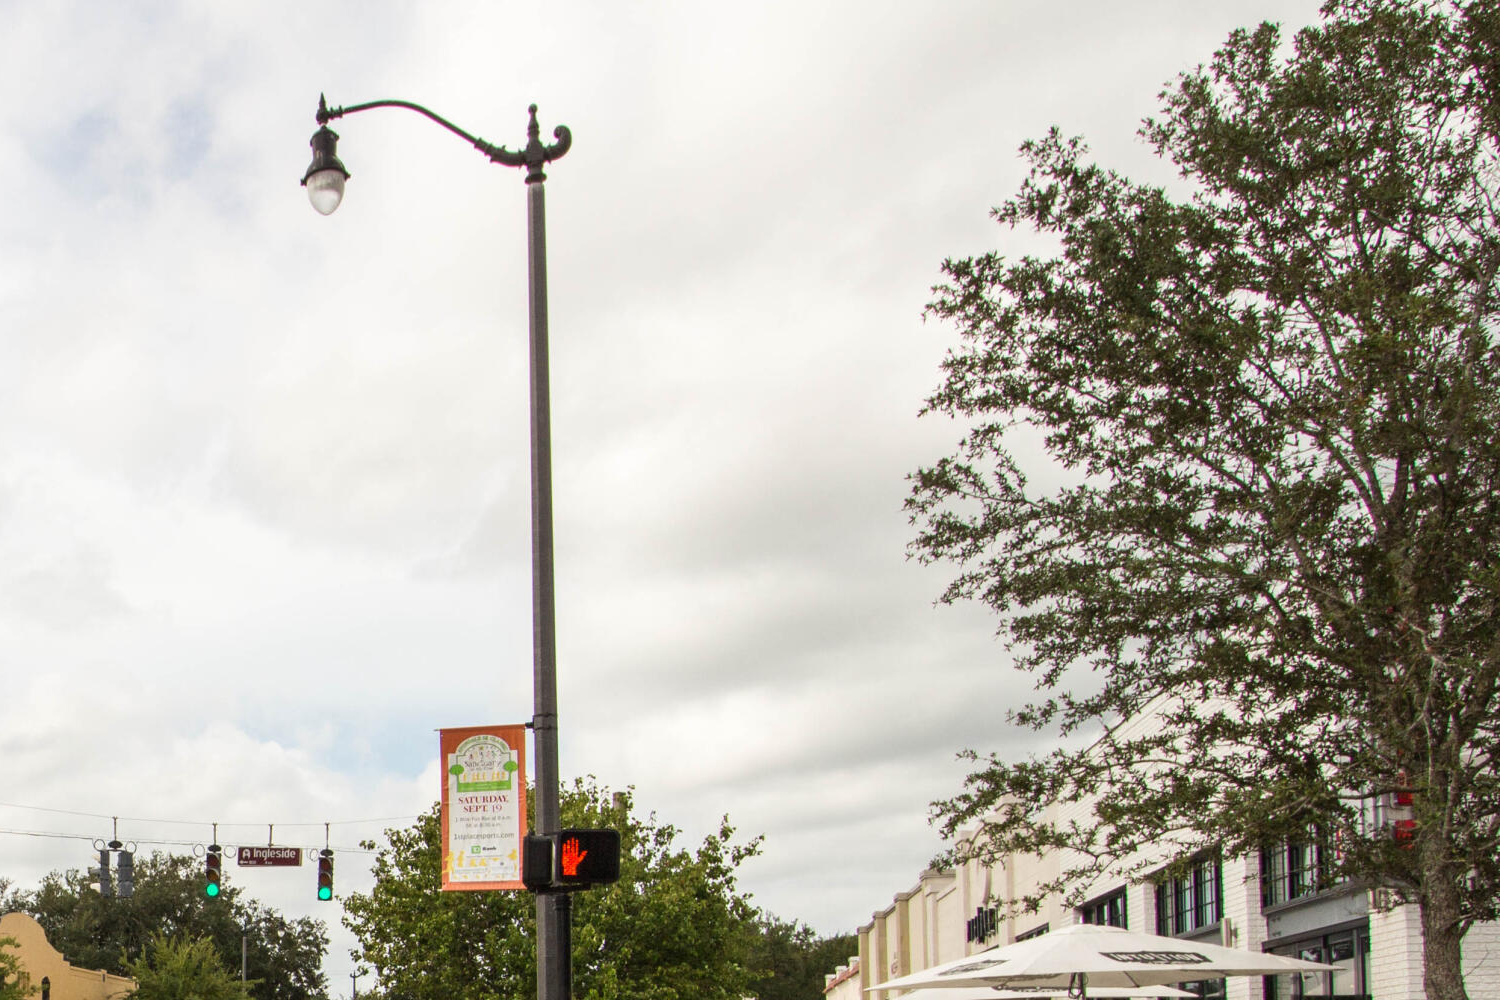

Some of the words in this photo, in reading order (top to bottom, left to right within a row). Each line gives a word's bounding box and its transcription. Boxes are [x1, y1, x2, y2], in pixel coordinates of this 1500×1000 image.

[458, 795, 509, 804] SATURDAY,
[463, 805, 487, 813] SEPT.
[492, 804, 503, 813] 19
[454, 832, 515, 841] 1stplacesports.com
[253, 848, 296, 861] Ingleside
[1109, 952, 1203, 962] INTUITION
